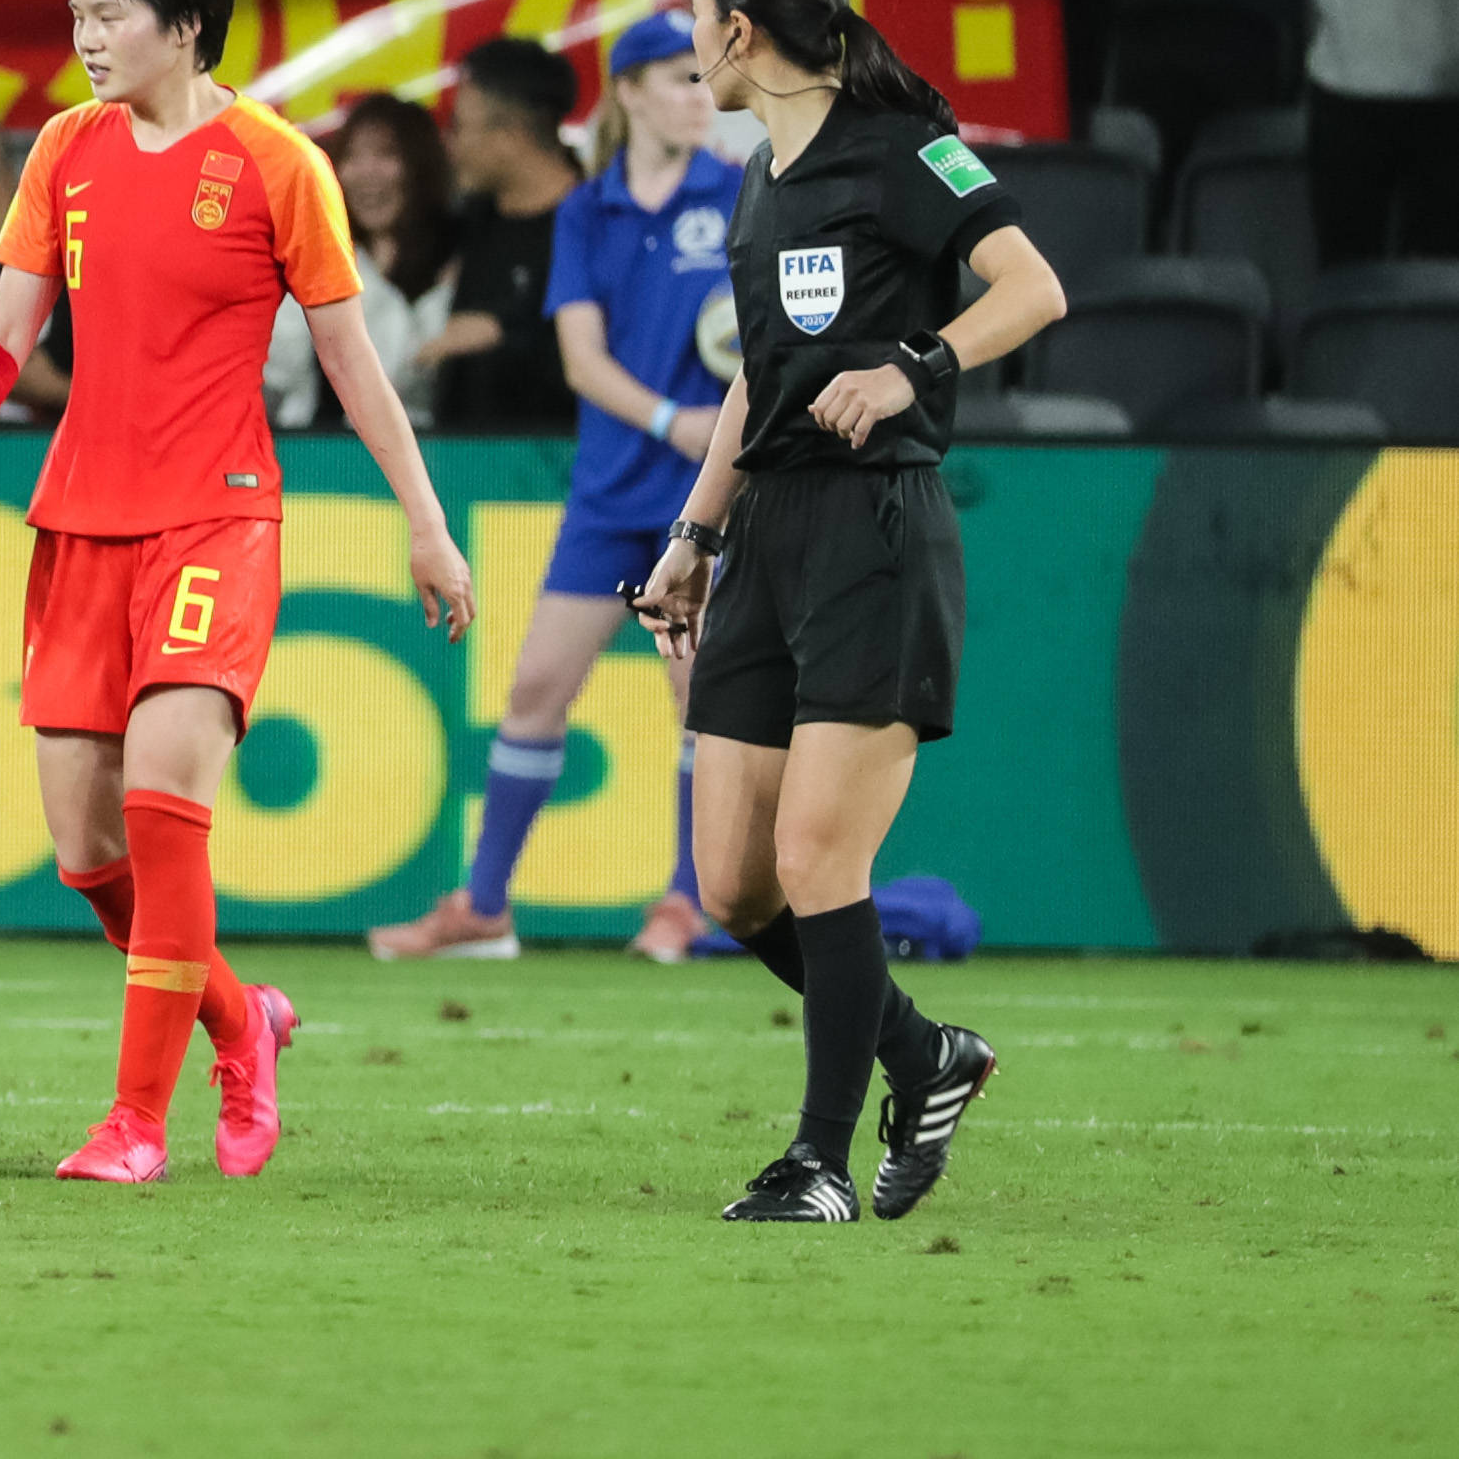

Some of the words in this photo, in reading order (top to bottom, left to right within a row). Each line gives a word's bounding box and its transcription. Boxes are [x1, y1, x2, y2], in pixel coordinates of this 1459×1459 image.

[784, 254, 835, 276] FIFA
[786, 286, 838, 300] REFEREE
[802, 315, 825, 326] 2020
[168, 565, 222, 645] 6
